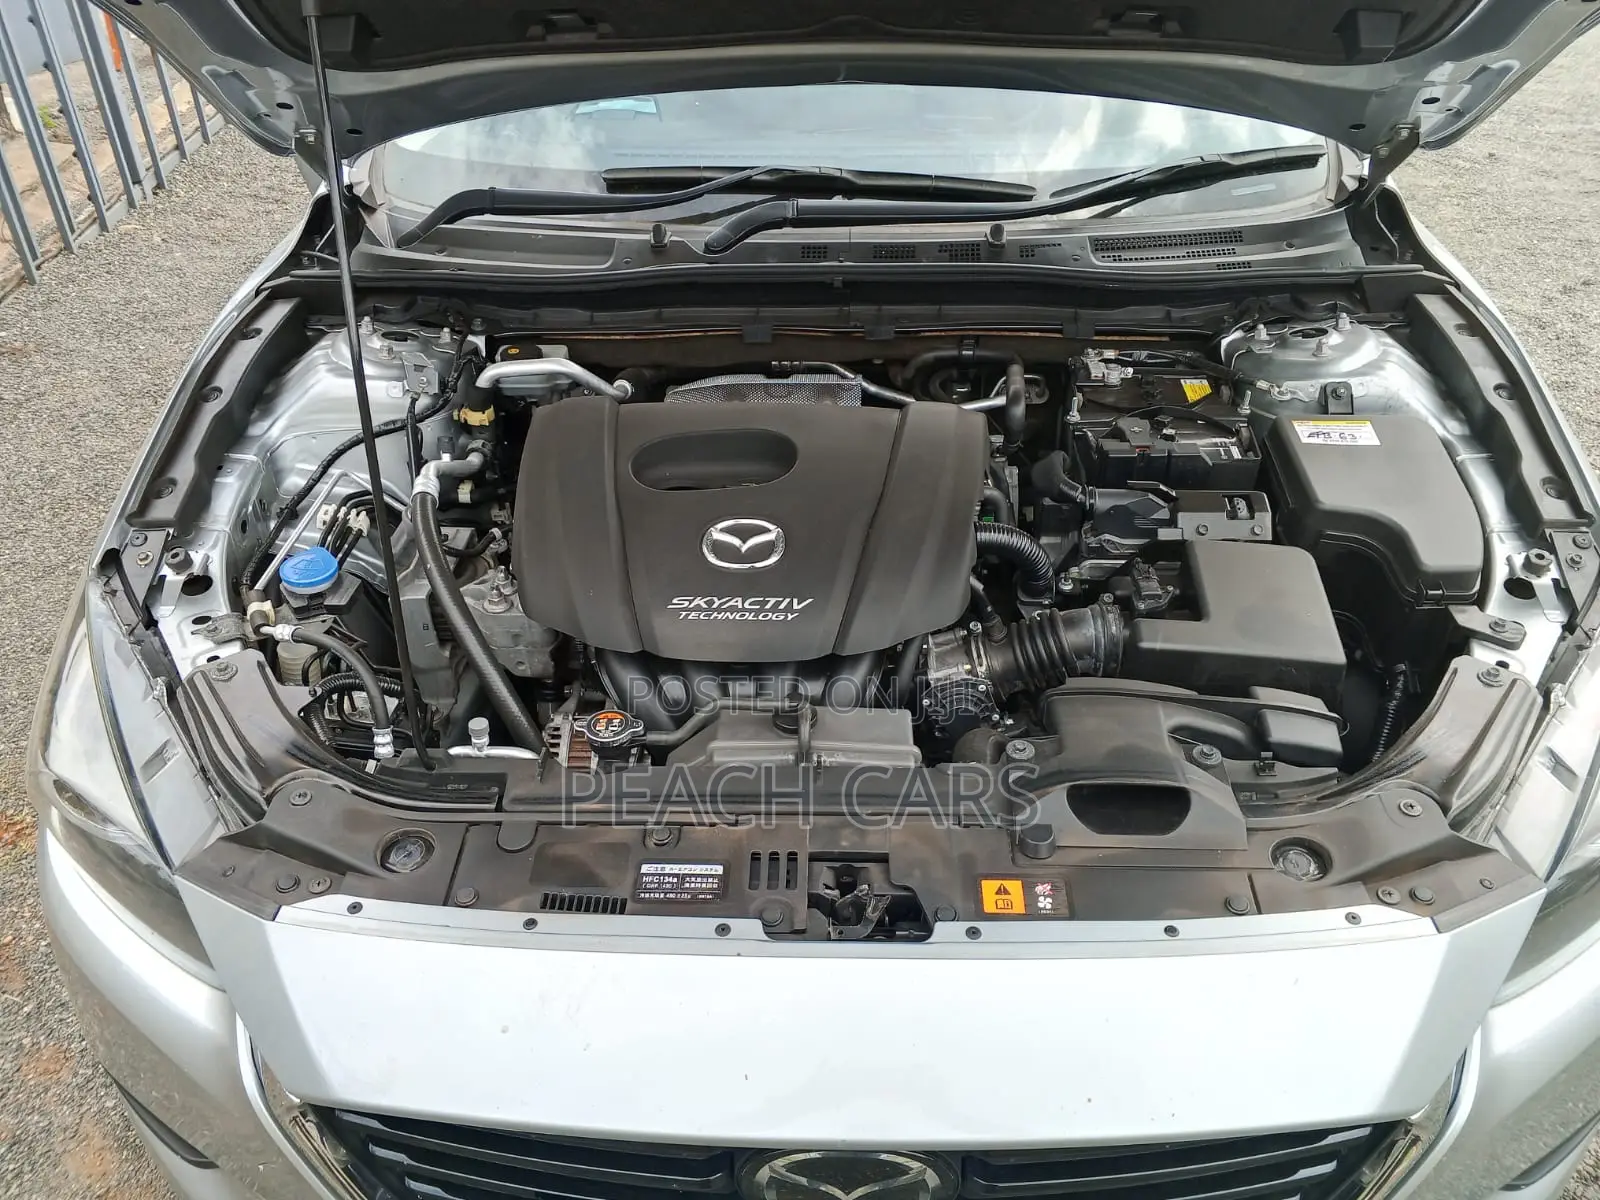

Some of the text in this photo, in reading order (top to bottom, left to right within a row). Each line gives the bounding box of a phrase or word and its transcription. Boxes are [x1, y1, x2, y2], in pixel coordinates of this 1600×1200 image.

[666, 596, 815, 610] SKYACTIV
[678, 611, 800, 621] TECHNOLOGY
[642, 875, 678, 883] HFC134a
